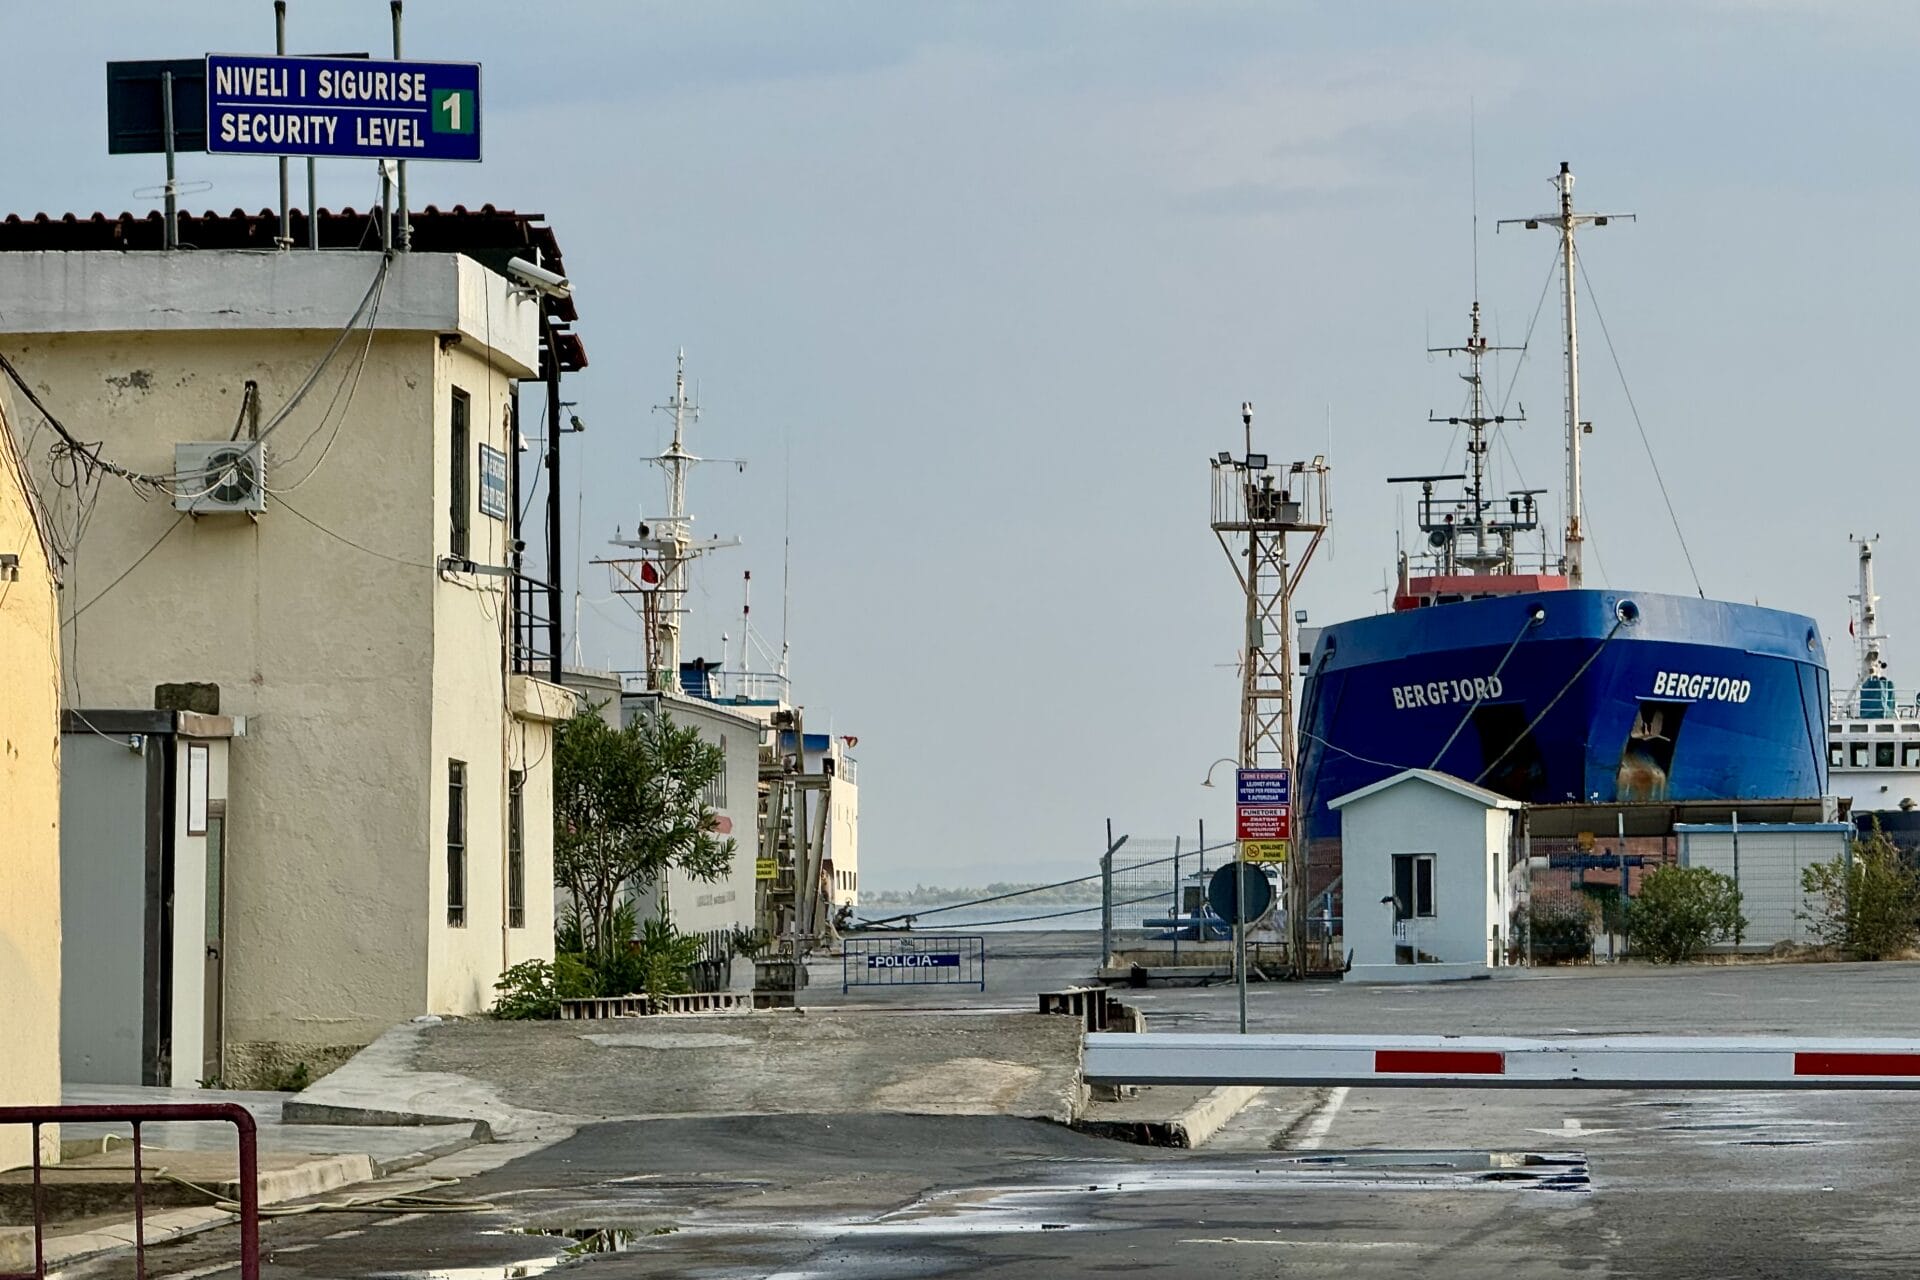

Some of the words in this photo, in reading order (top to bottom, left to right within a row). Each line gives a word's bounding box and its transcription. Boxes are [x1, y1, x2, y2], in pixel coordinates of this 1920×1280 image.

[216, 66, 288, 97] NIVELI
[300, 69, 306, 97] I
[318, 69, 427, 102] SIGURISE
[442, 92, 461, 130] 1
[220, 112, 338, 145] SECURITY
[356, 117, 425, 148] LEVEL
[1392, 675, 1503, 709] BERGFJORD
[1653, 671, 1751, 703] BERGFJORD
